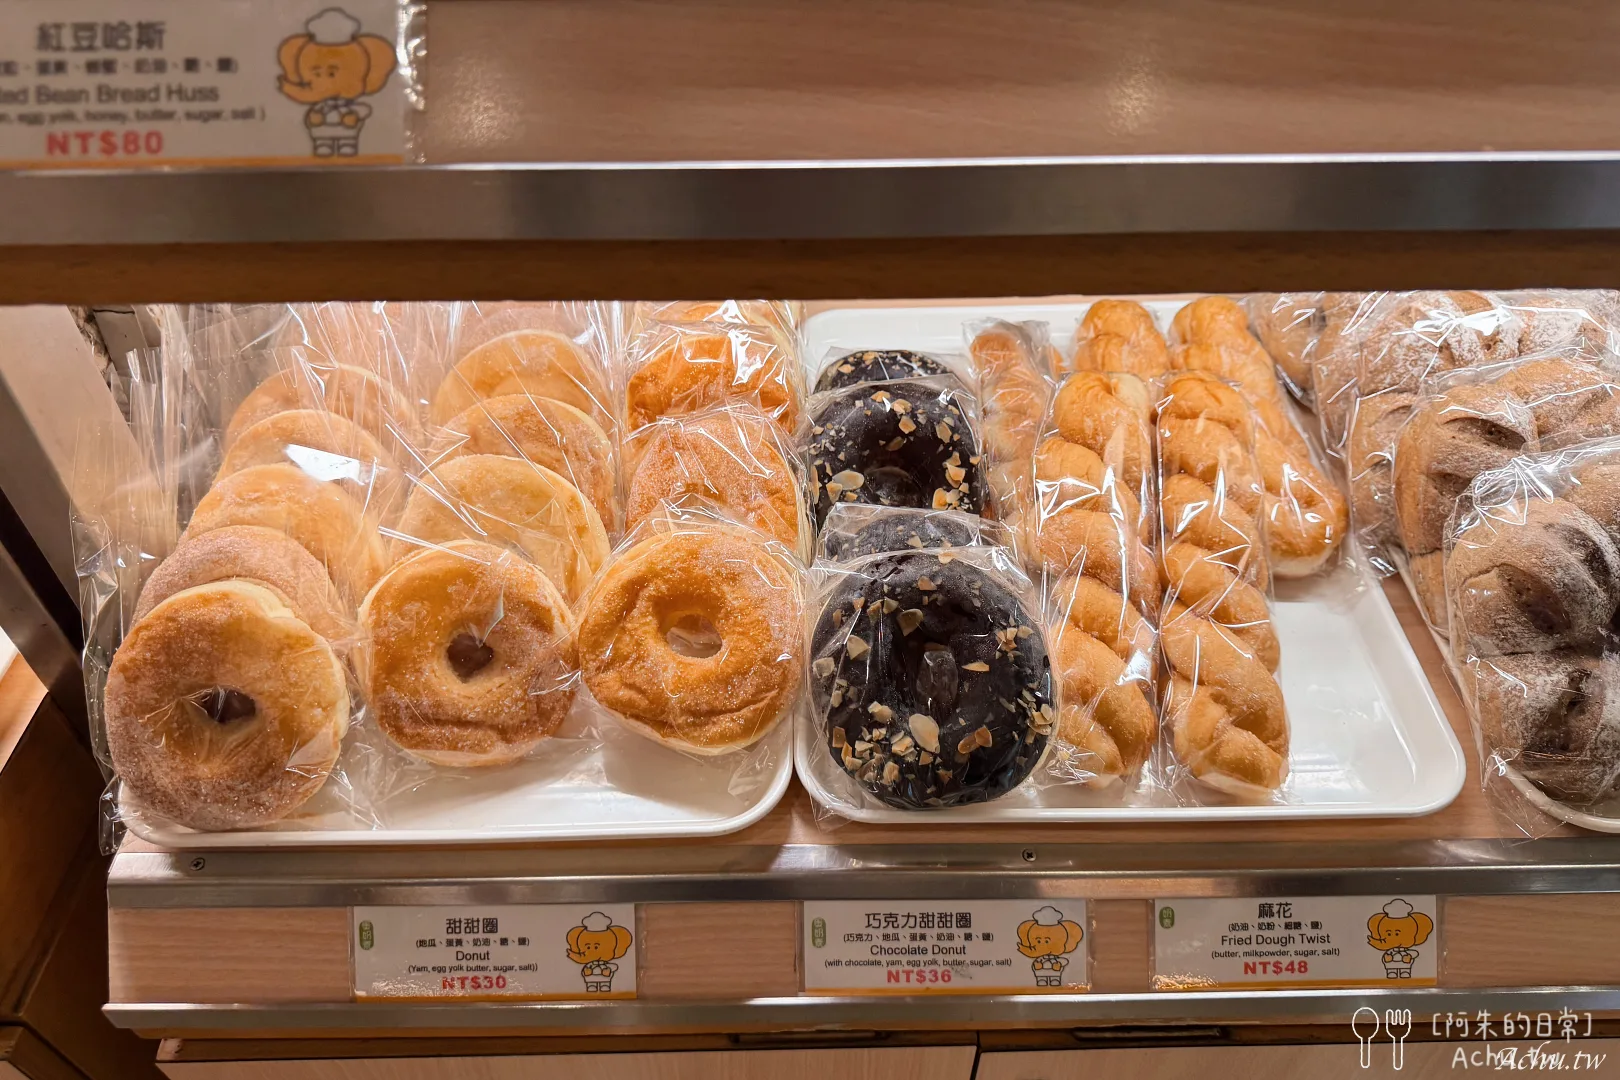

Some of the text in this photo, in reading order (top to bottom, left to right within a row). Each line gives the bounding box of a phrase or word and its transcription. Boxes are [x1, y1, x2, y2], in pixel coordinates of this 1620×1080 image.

[37, 20, 166, 51] 紅豆哈斯
[36, 84, 89, 103] Bean
[97, 83, 160, 103] Bread
[167, 83, 219, 102] Huss
[46, 130, 164, 155] NT$80
[1258, 902, 1293, 919] 麻花
[446, 917, 498, 935] 甜甜圈
[865, 912, 972, 929] 巧克力甜甜圈
[1221, 933, 1331, 947] Fried Dough Twist
[456, 950, 490, 961] Donut
[870, 944, 966, 956] Chocolate Donut
[1211, 948, 1340, 959] (butter, milkpowder, sugar, salt)
[408, 965, 430, 974] (Yam,
[432, 965, 446, 973] egg
[449, 964, 464, 972] yolk
[466, 964, 491, 972] butter,
[493, 964, 517, 973] sugar,
[824, 958, 843, 968] (with
[844, 958, 884, 968] chocolate,
[885, 960, 905, 968] yam,
[906, 960, 920, 969] egg
[922, 958, 941, 968] yolk,
[970, 959, 994, 968] sugar,
[995, 958, 1012, 967] salt)
[1243, 960, 1309, 975] NT$48
[442, 975, 507, 990] NT$30
[887, 968, 952, 984] NT$36
